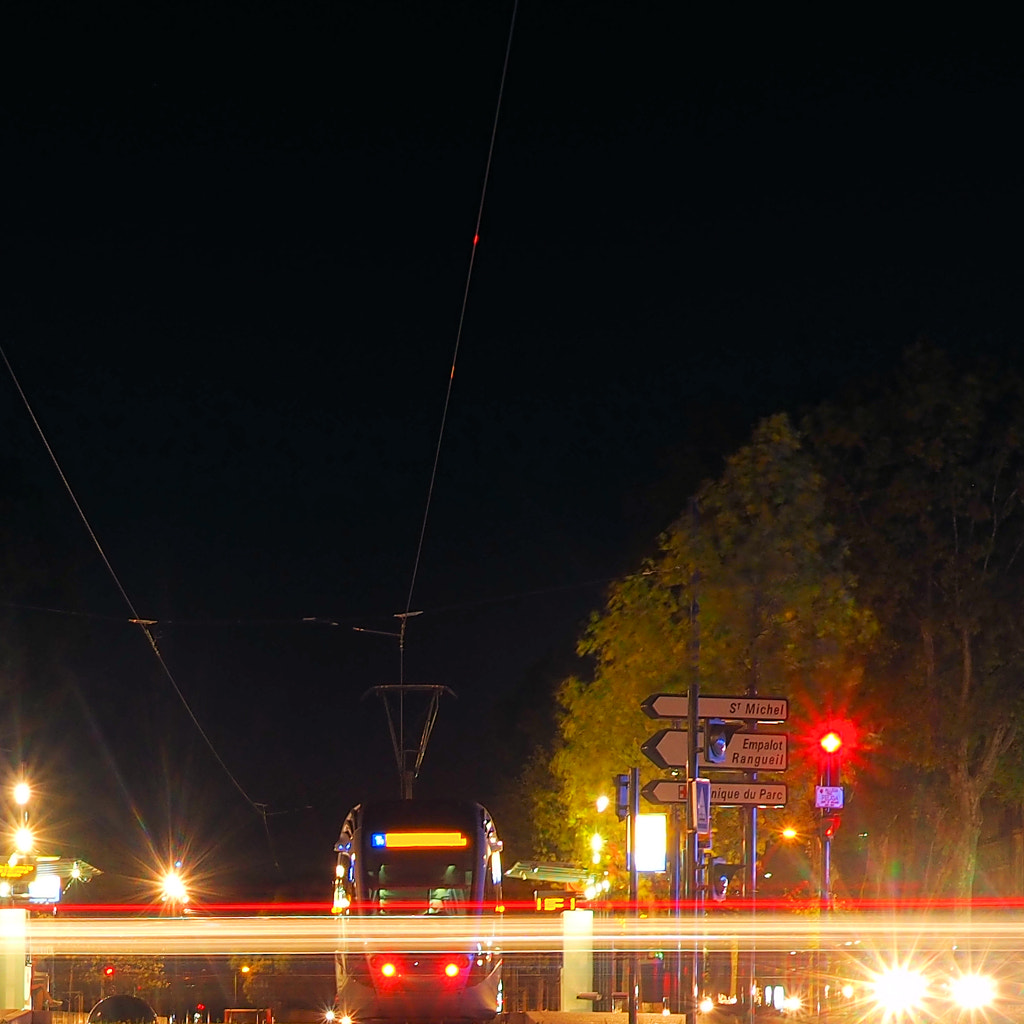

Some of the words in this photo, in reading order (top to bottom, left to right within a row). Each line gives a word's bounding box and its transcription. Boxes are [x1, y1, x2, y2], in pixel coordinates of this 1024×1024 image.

[745, 702, 784, 715] Michel
[742, 738, 783, 751] Empalot
[731, 752, 784, 767] Rangueil
[711, 787, 740, 802] nique
[743, 788, 756, 799] du
[759, 789, 783, 800] Parc
